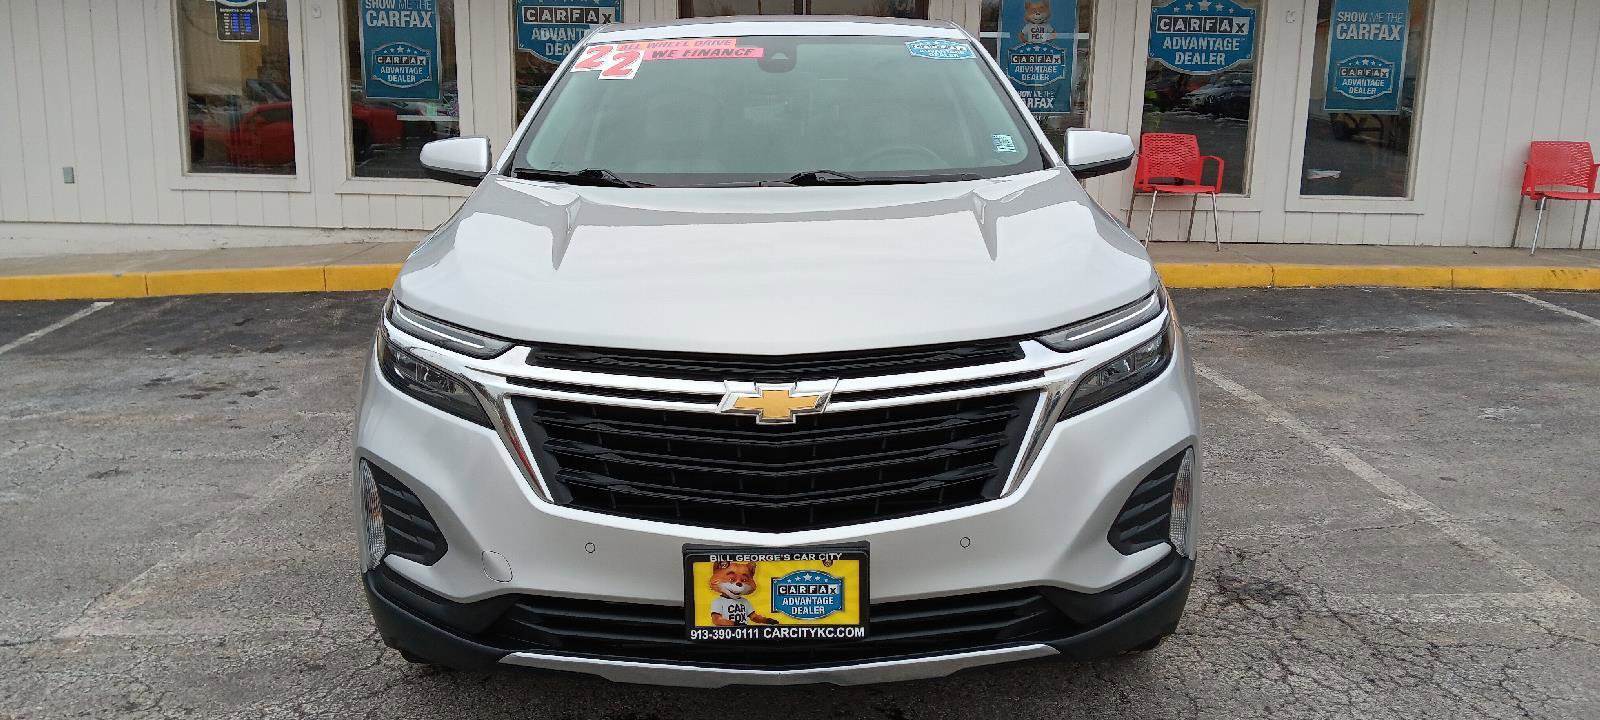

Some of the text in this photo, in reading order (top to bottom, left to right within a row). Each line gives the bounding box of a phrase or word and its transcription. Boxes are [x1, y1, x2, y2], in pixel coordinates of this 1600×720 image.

[366, 0, 395, 9] SHOW
[366, 10, 433, 28] CARFAX
[526, 9, 613, 23] CARFAX
[1337, 12, 1404, 23] SHOW ME THE
[1031, 26, 1045, 34] CAR
[1160, 19, 1246, 34] CARFAX
[1336, 23, 1403, 40] CARFAX
[646, 40, 689, 49] WHEEL
[1162, 36, 1240, 51] ADVANTAGE
[652, 48, 754, 59] WE FINANCE
[1174, 51, 1226, 65] DEALER
[377, 56, 427, 66] CARFAX
[1012, 56, 1060, 64] CARFAX
[380, 66, 423, 75] ADVANTAGE
[1015, 65, 1057, 73] ADVANTAGE
[1340, 69, 1388, 78] CARFAX
[387, 74, 416, 82] DEALER
[1021, 73, 1050, 81] DEALER
[1342, 79, 1385, 87] ADVANTAGE
[1348, 87, 1377, 95] DEALER
[709, 552, 842, 562] BILL GEORGE'S CAR CITY
[779, 585, 838, 595] CARFAX
[782, 597, 834, 606] ADVANTAGE
[727, 604, 746, 613] CAR
[791, 606, 825, 615] DEALER
[690, 627, 865, 640] 913-390-0111 CARCITYKC.COM
